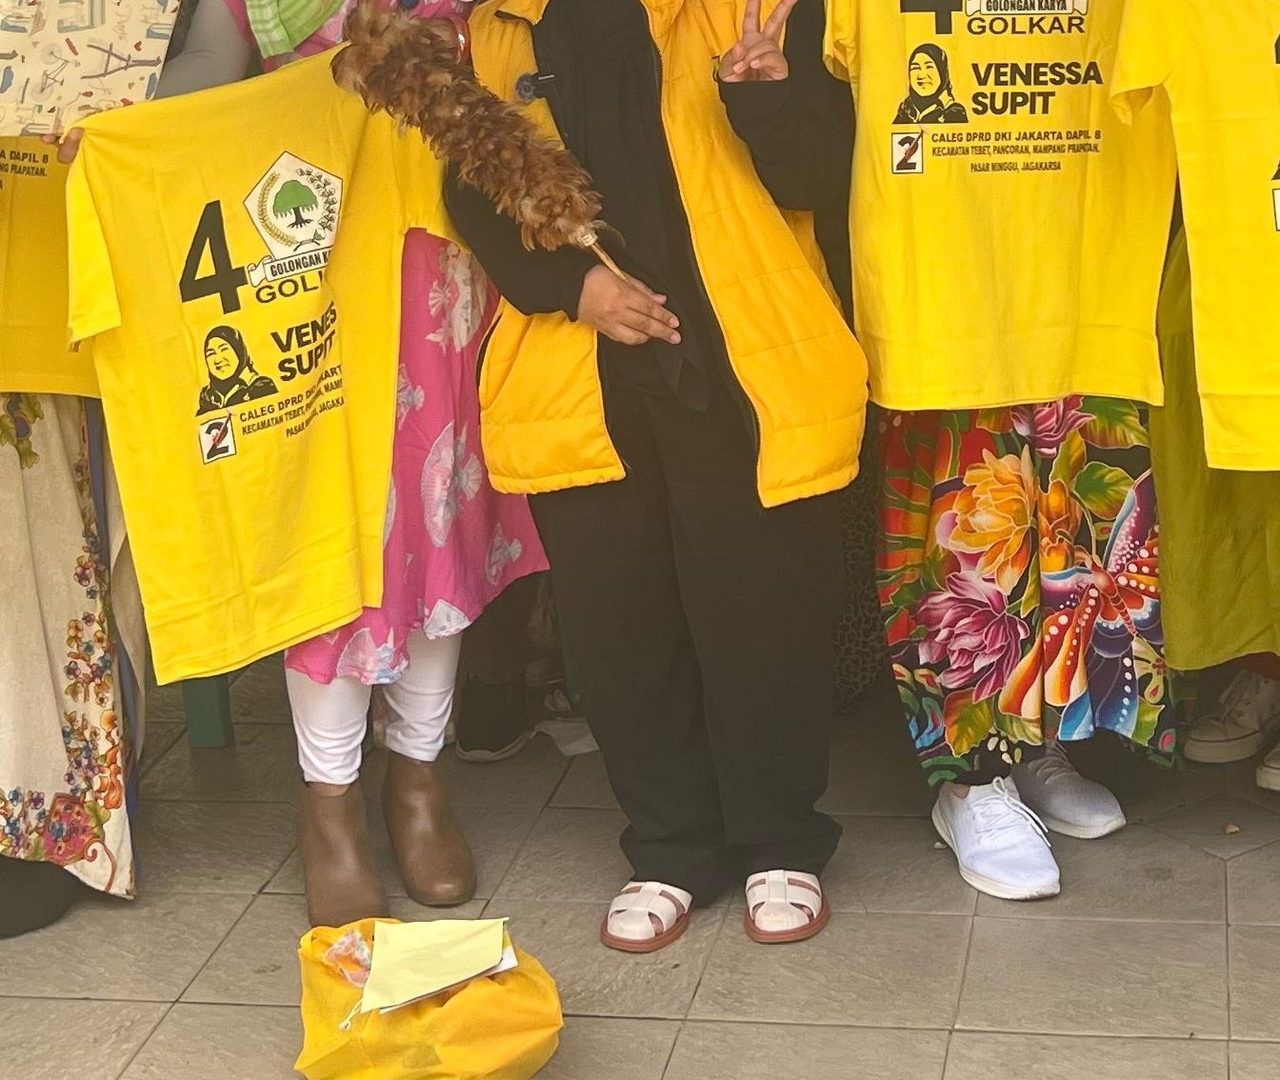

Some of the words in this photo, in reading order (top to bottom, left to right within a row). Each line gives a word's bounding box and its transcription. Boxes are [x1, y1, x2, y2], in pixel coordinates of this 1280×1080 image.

[986, 0, 1035, 11] GOLONGAN
[1038, 0, 1067, 11] KARYA
[966, 17, 1085, 34] GOLKAR
[971, 62, 1103, 86] VENESSA
[972, 92, 1055, 115] SUPIT
[932, 133, 963, 143] CALEG
[966, 133, 990, 142] DPRD
[995, 132, 1011, 141] DKI
[1015, 131, 1063, 141] JAKARTA
[1066, 130, 1090, 140] DAPIL
[1094, 130, 1101, 140] 8
[10, 150, 38, 163] DAPIL
[42, 154, 49, 164] 8
[896, 136, 919, 171] 2
[179, 200, 249, 314] 4
[270, 255, 321, 277] GOLONGAN
[239, 403, 275, 422] CALEG
[278, 394, 303, 411] DPRD
[242, 415, 284, 435] KECAMATAN
[206, 421, 229, 460] 2
